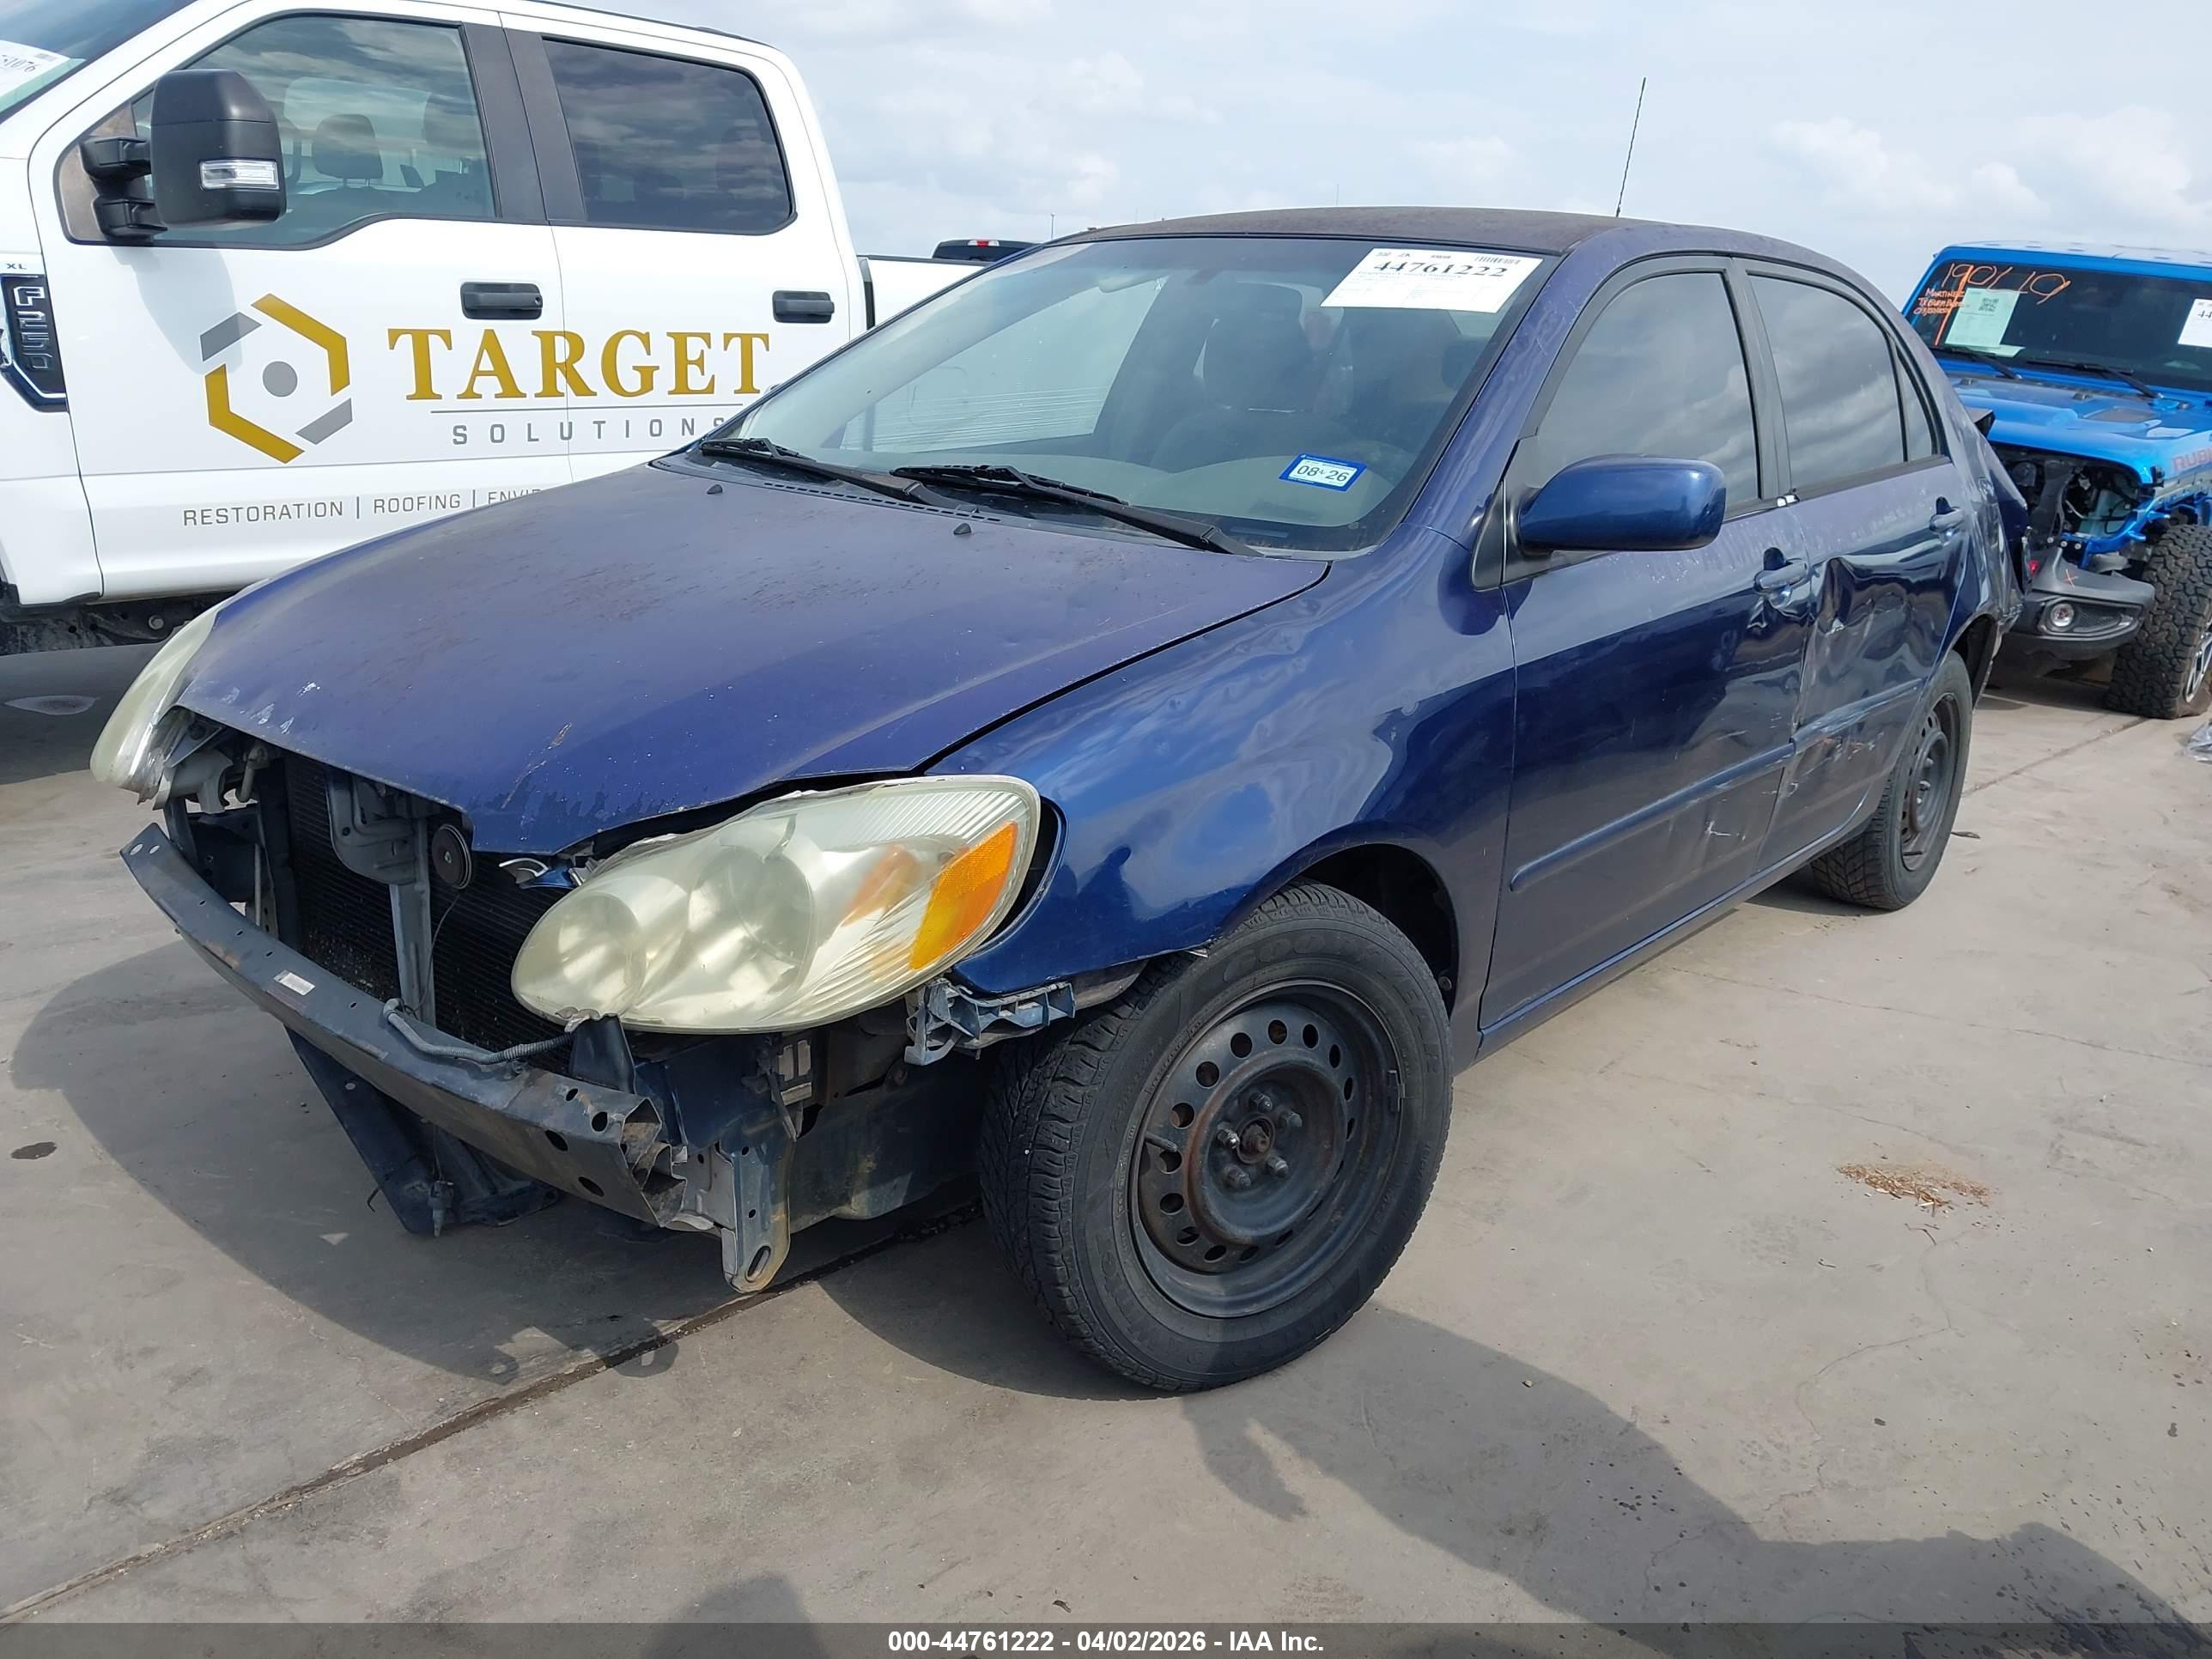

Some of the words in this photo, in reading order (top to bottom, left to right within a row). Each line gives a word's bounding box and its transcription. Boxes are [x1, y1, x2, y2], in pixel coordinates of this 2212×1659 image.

[1374, 260, 1508, 277] 44761222
[387, 328, 769, 401] TARGET
[1297, 465, 1320, 477] 08
[1325, 470, 1350, 482] 26
[183, 501, 343, 526] RESTORATION
[374, 494, 461, 514] ROOFING
[488, 489, 541, 505] ENV
[1223, 933, 1441, 1074] GOODYEAR
